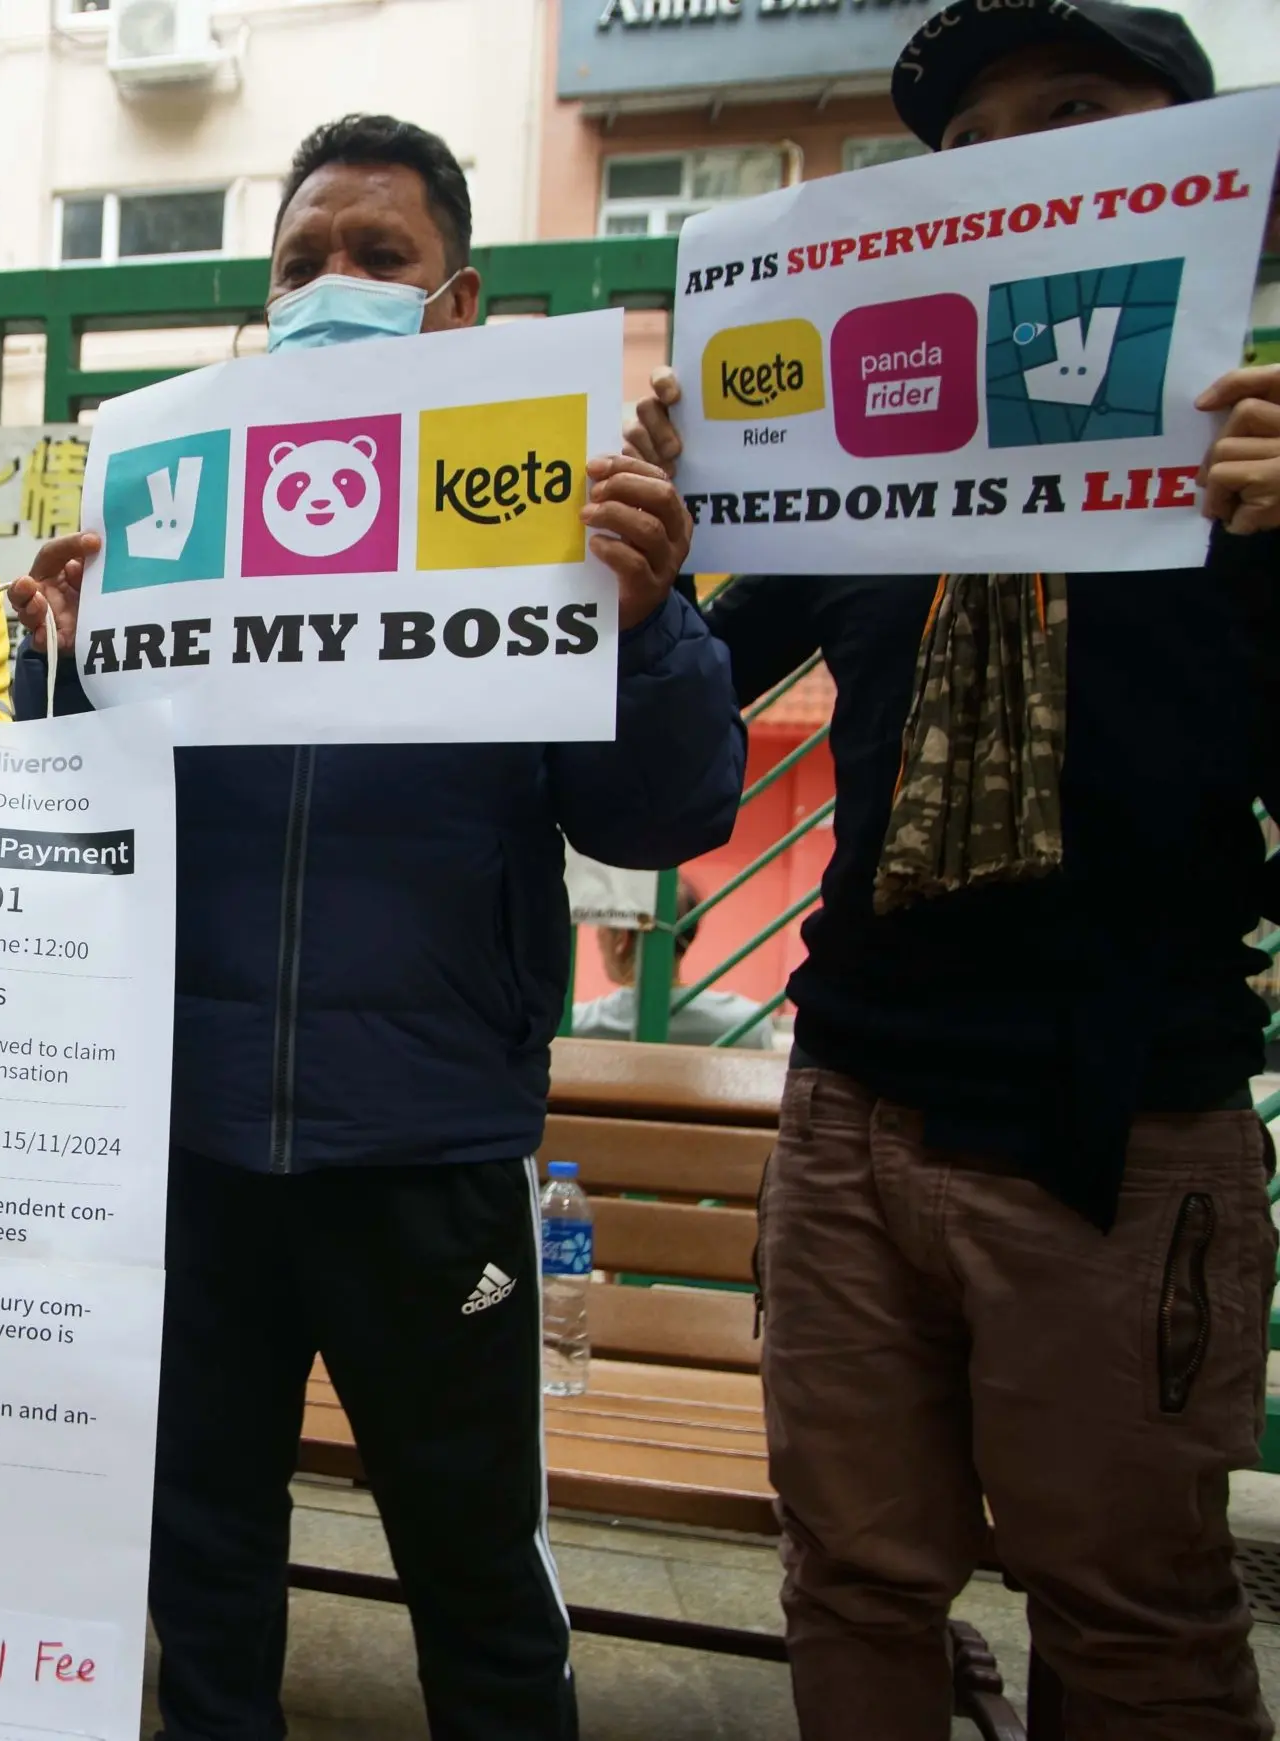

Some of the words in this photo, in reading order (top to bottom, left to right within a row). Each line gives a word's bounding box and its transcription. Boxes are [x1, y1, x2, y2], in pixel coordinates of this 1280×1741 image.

[685, 261, 745, 295] APP
[750, 252, 779, 282] IS
[786, 194, 1083, 275] SUPERVISION
[1093, 168, 1251, 221] TOOL
[860, 341, 943, 380] panda
[721, 353, 804, 407] keeta
[871, 383, 934, 411] rider
[742, 427, 787, 447] Rider
[434, 450, 572, 525] keeta
[685, 481, 938, 526] FREEDOM
[951, 476, 1008, 517] IS
[1022, 474, 1066, 514] A
[1081, 464, 1203, 511] LIE
[84, 618, 212, 676] ARE
[232, 612, 359, 664] MY
[379, 602, 599, 661] BOSS
[1, 837, 129, 866] Payment
[39, 1042, 58, 1058] to
[63, 1043, 116, 1062] claim
[2, 1130, 122, 1157] 15/11/2024
[71, 1205, 115, 1222] con-
[39, 1301, 92, 1318] com-
[58, 1326, 74, 1344] is
[19, 1404, 57, 1422] and
[64, 1410, 97, 1425] an-
[35, 1640, 96, 1682] Fee
